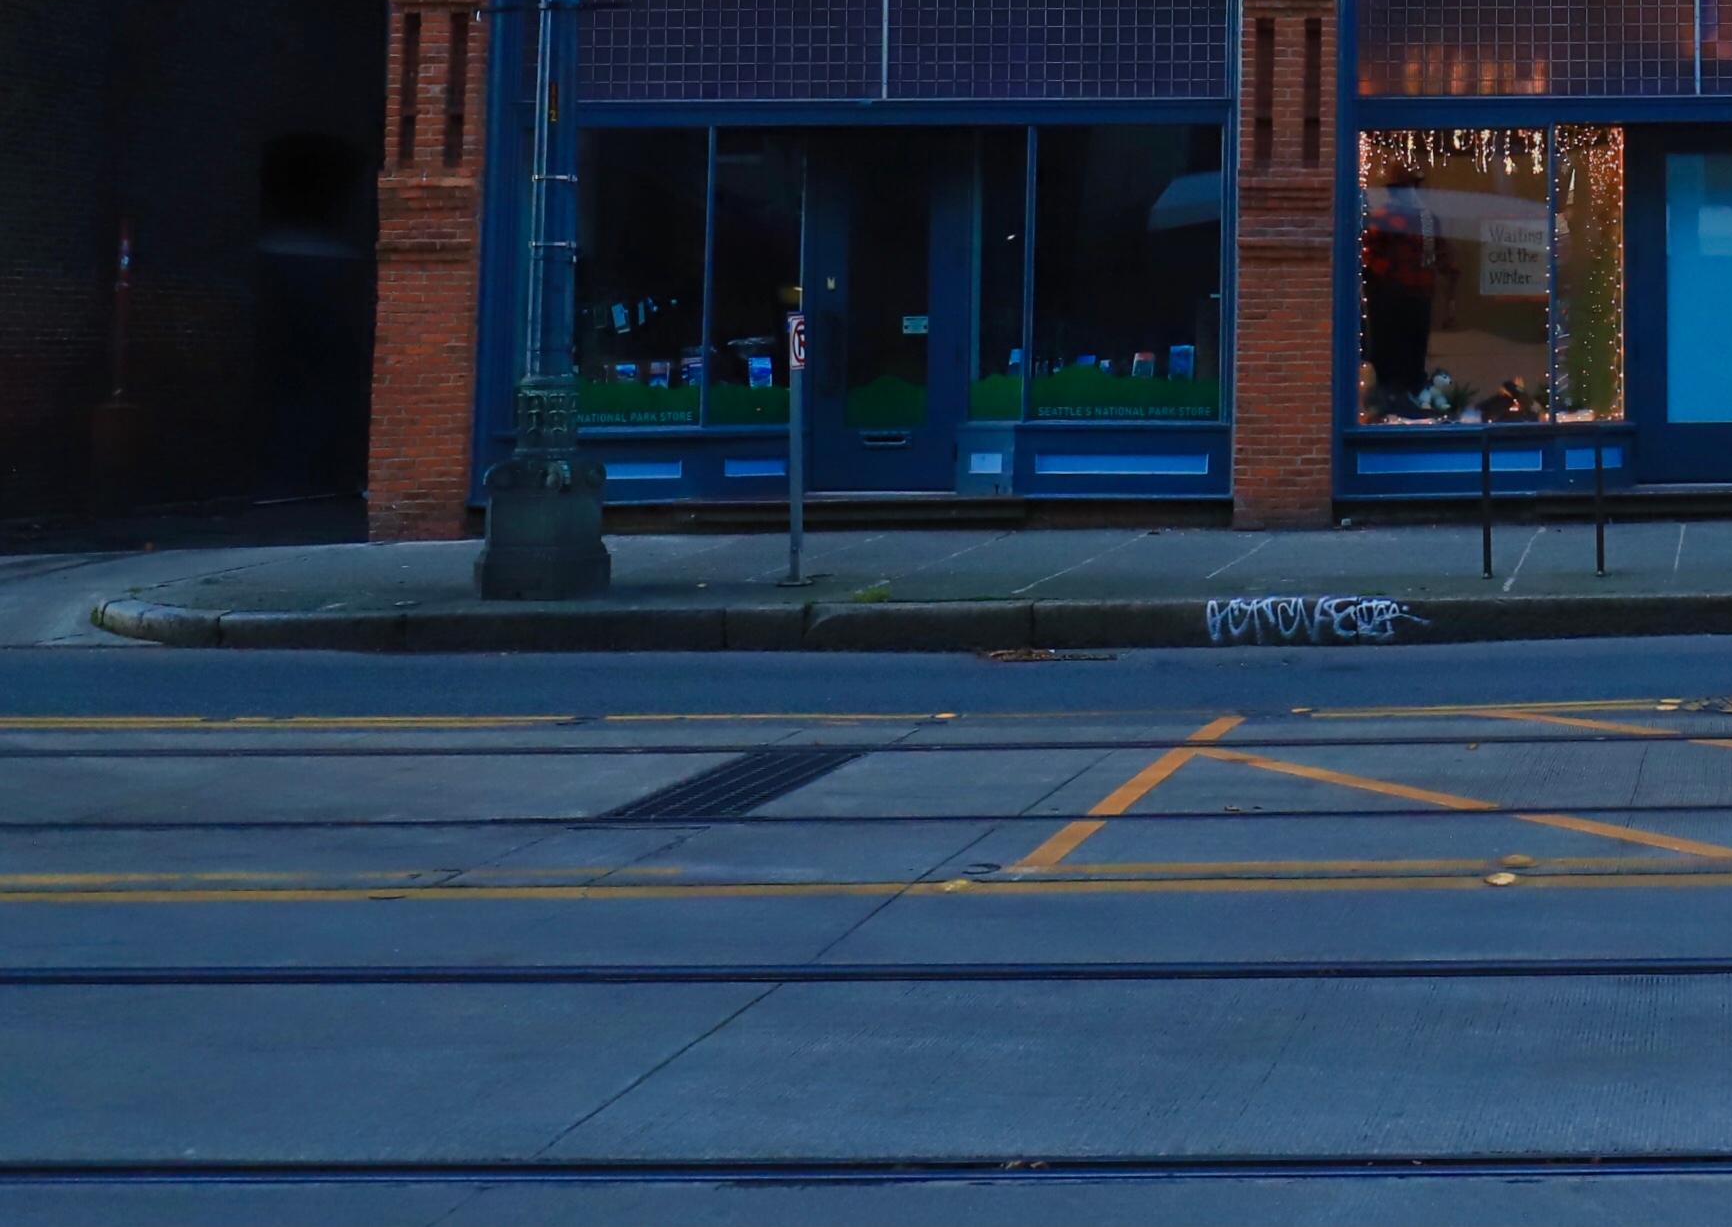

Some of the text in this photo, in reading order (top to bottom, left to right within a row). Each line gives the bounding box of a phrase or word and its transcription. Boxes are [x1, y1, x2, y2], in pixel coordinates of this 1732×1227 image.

[1489, 226, 1543, 245] Waiting
[1488, 248, 1538, 263] out the
[576, 411, 693, 423] NATIONAL PARK STORE
[1094, 406, 1146, 417] NATIONAL
[1148, 406, 1176, 417] PARK
[1179, 406, 1211, 417] STORE
